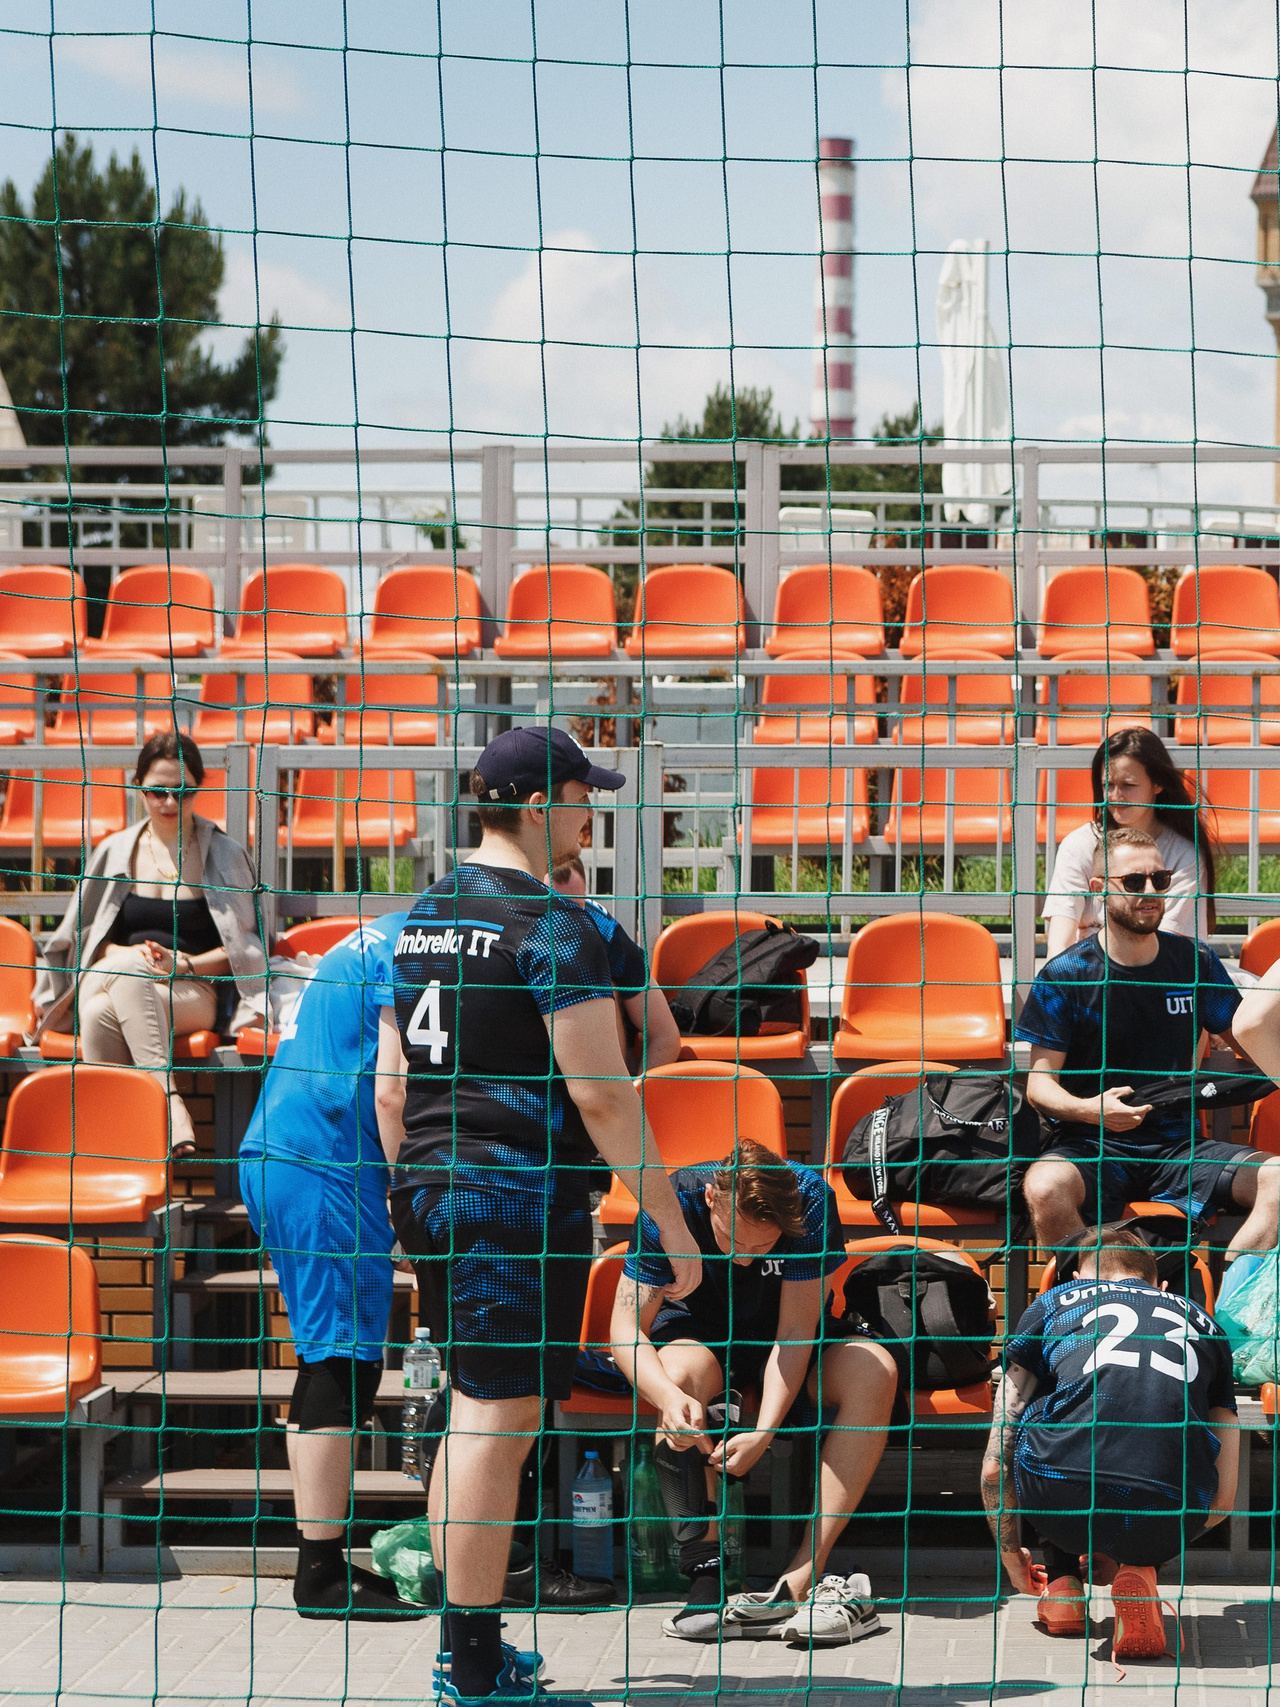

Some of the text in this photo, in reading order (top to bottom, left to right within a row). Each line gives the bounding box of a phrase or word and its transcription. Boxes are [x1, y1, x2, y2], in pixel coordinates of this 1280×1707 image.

[467, 929, 500, 958] IT
[406, 979, 449, 1064] 4
[1059, 1284, 1192, 1313] Umbrella
[1082, 1303, 1200, 1384] 23
